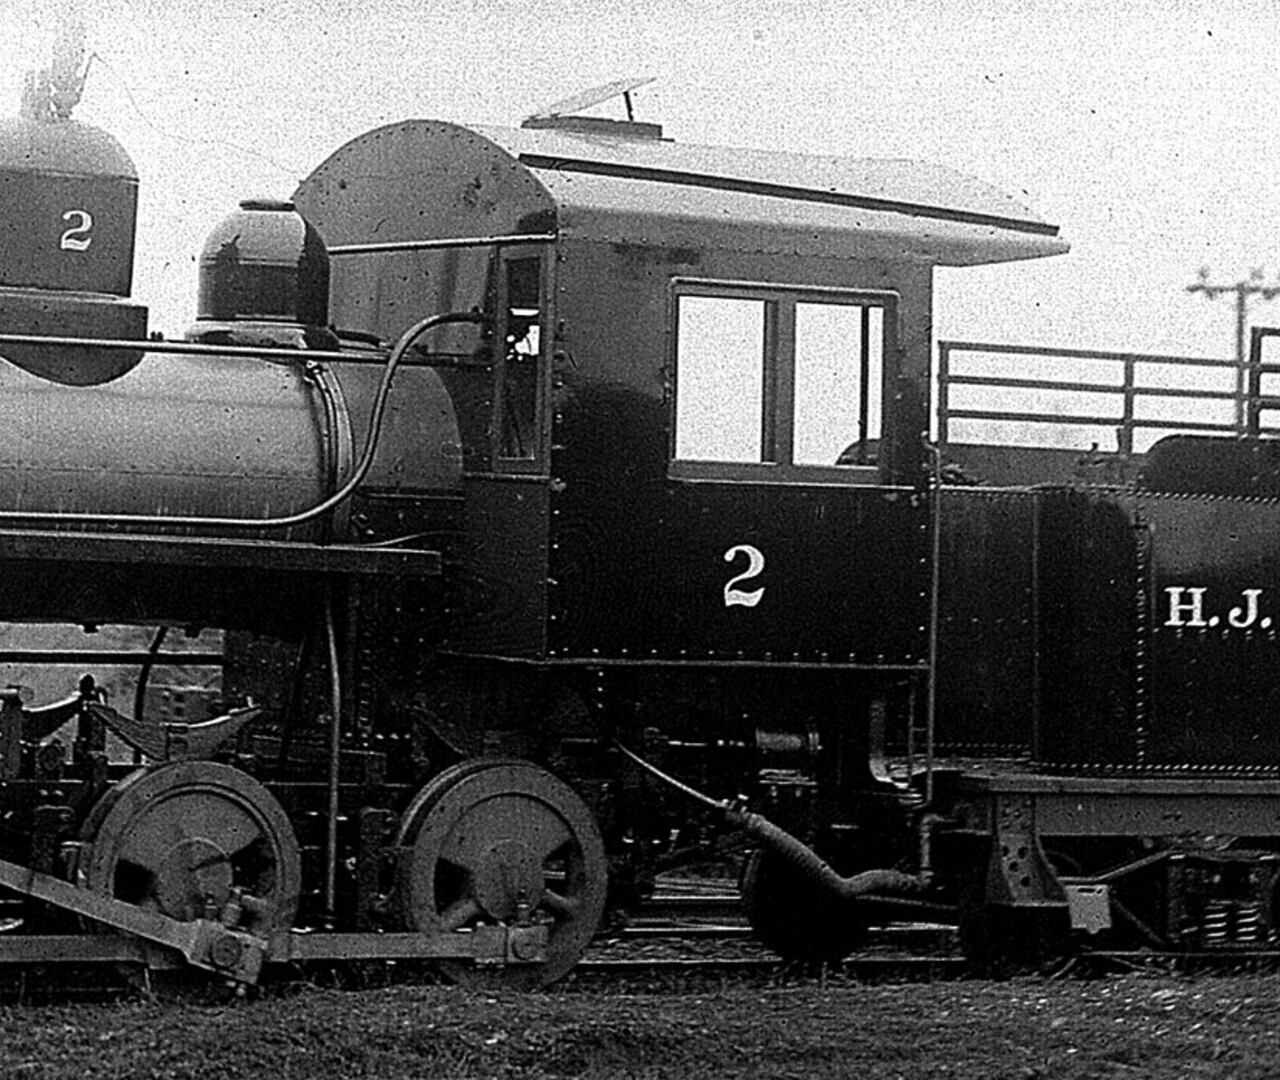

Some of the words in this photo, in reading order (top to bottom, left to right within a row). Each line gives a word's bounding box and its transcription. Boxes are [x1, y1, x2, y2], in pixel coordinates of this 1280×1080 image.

[61, 210, 92, 251] 2
[724, 544, 765, 607] 2
[1164, 587, 1219, 627] H.
[1228, 589, 1272, 629] J.
